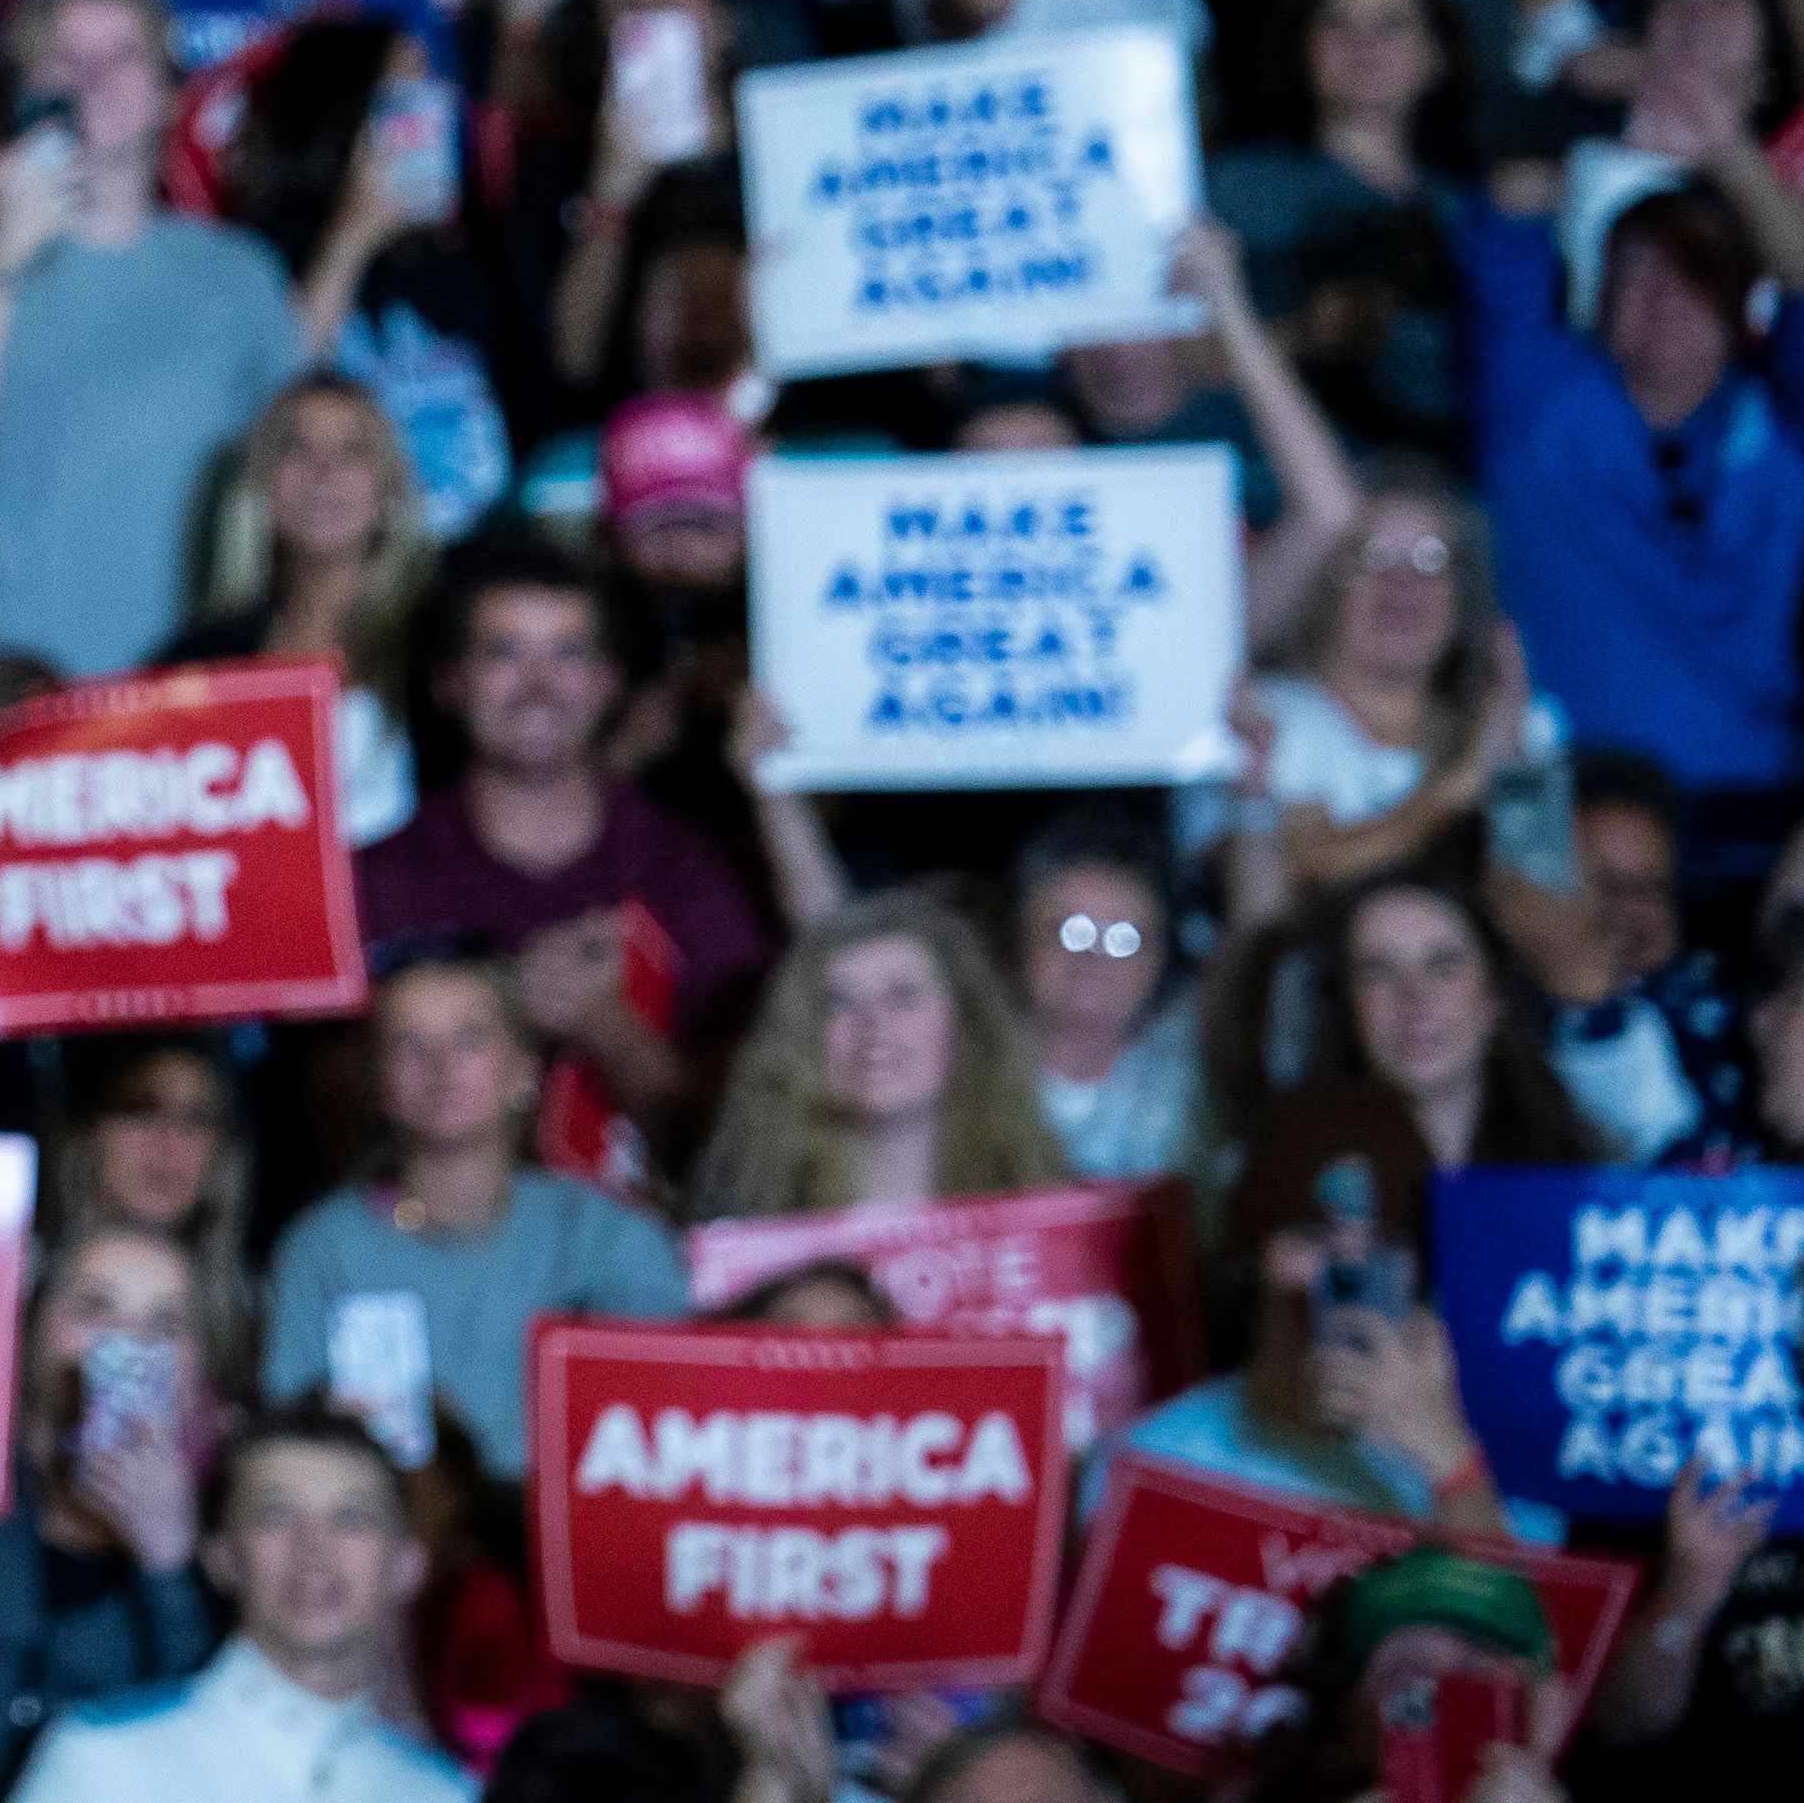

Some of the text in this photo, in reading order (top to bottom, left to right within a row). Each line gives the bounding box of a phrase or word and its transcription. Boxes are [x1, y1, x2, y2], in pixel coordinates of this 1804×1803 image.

[856, 70, 1055, 136] MAKE
[814, 123, 1119, 208] AMERICA
[859, 185, 1083, 254] GREAT
[881, 490, 1101, 544] MAKE
[821, 542, 1167, 610] AMERICA
[871, 604, 1119, 670] GREAT
[1499, 1268, 1804, 1346] AMERI
[1555, 1342, 1801, 1409] GREA
[574, 1402, 1034, 1507] AMERICA
[662, 1519, 951, 1621] FIRST
